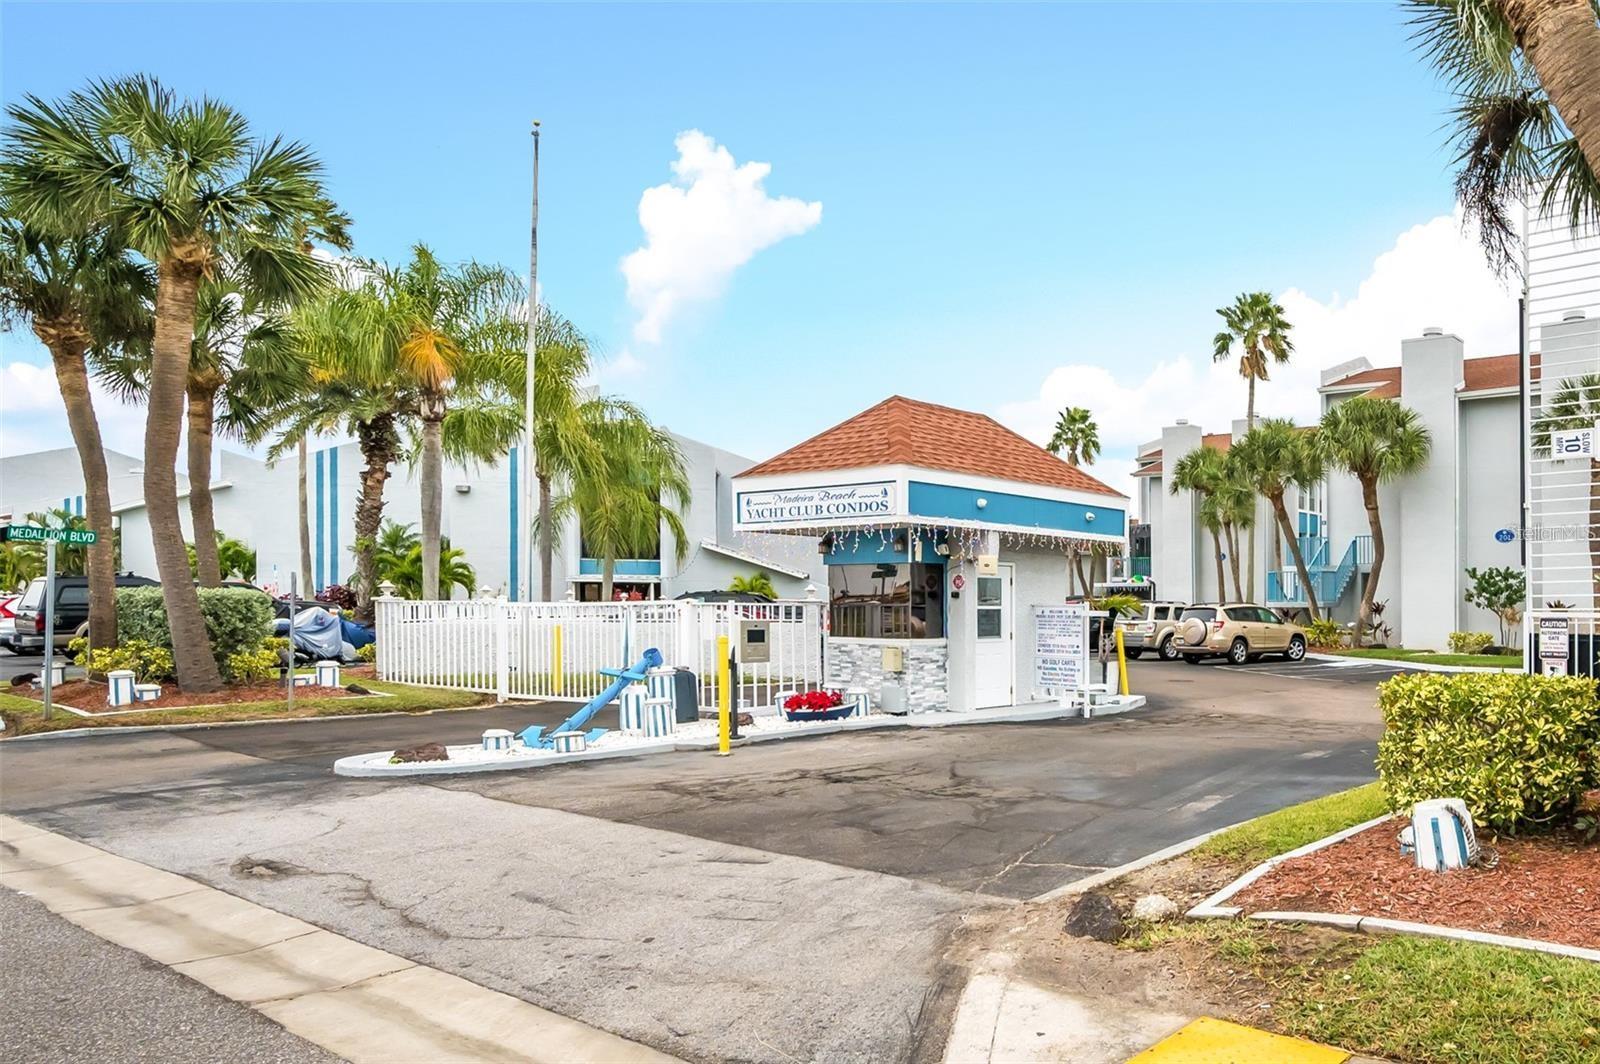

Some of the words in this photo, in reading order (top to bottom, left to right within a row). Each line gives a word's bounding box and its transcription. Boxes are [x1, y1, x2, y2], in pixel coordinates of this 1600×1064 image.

[1565, 435, 1581, 453] 10
[1582, 432, 1590, 454] SLOW
[773, 494, 814, 506] Madeira
[818, 489, 857, 502] Beach
[747, 507, 786, 519] YACHT
[789, 504, 823, 518] CLUB
[826, 500, 889, 514] CONDOS
[10, 527, 67, 541] MEDALLION
[70, 531, 95, 543] BLVD
